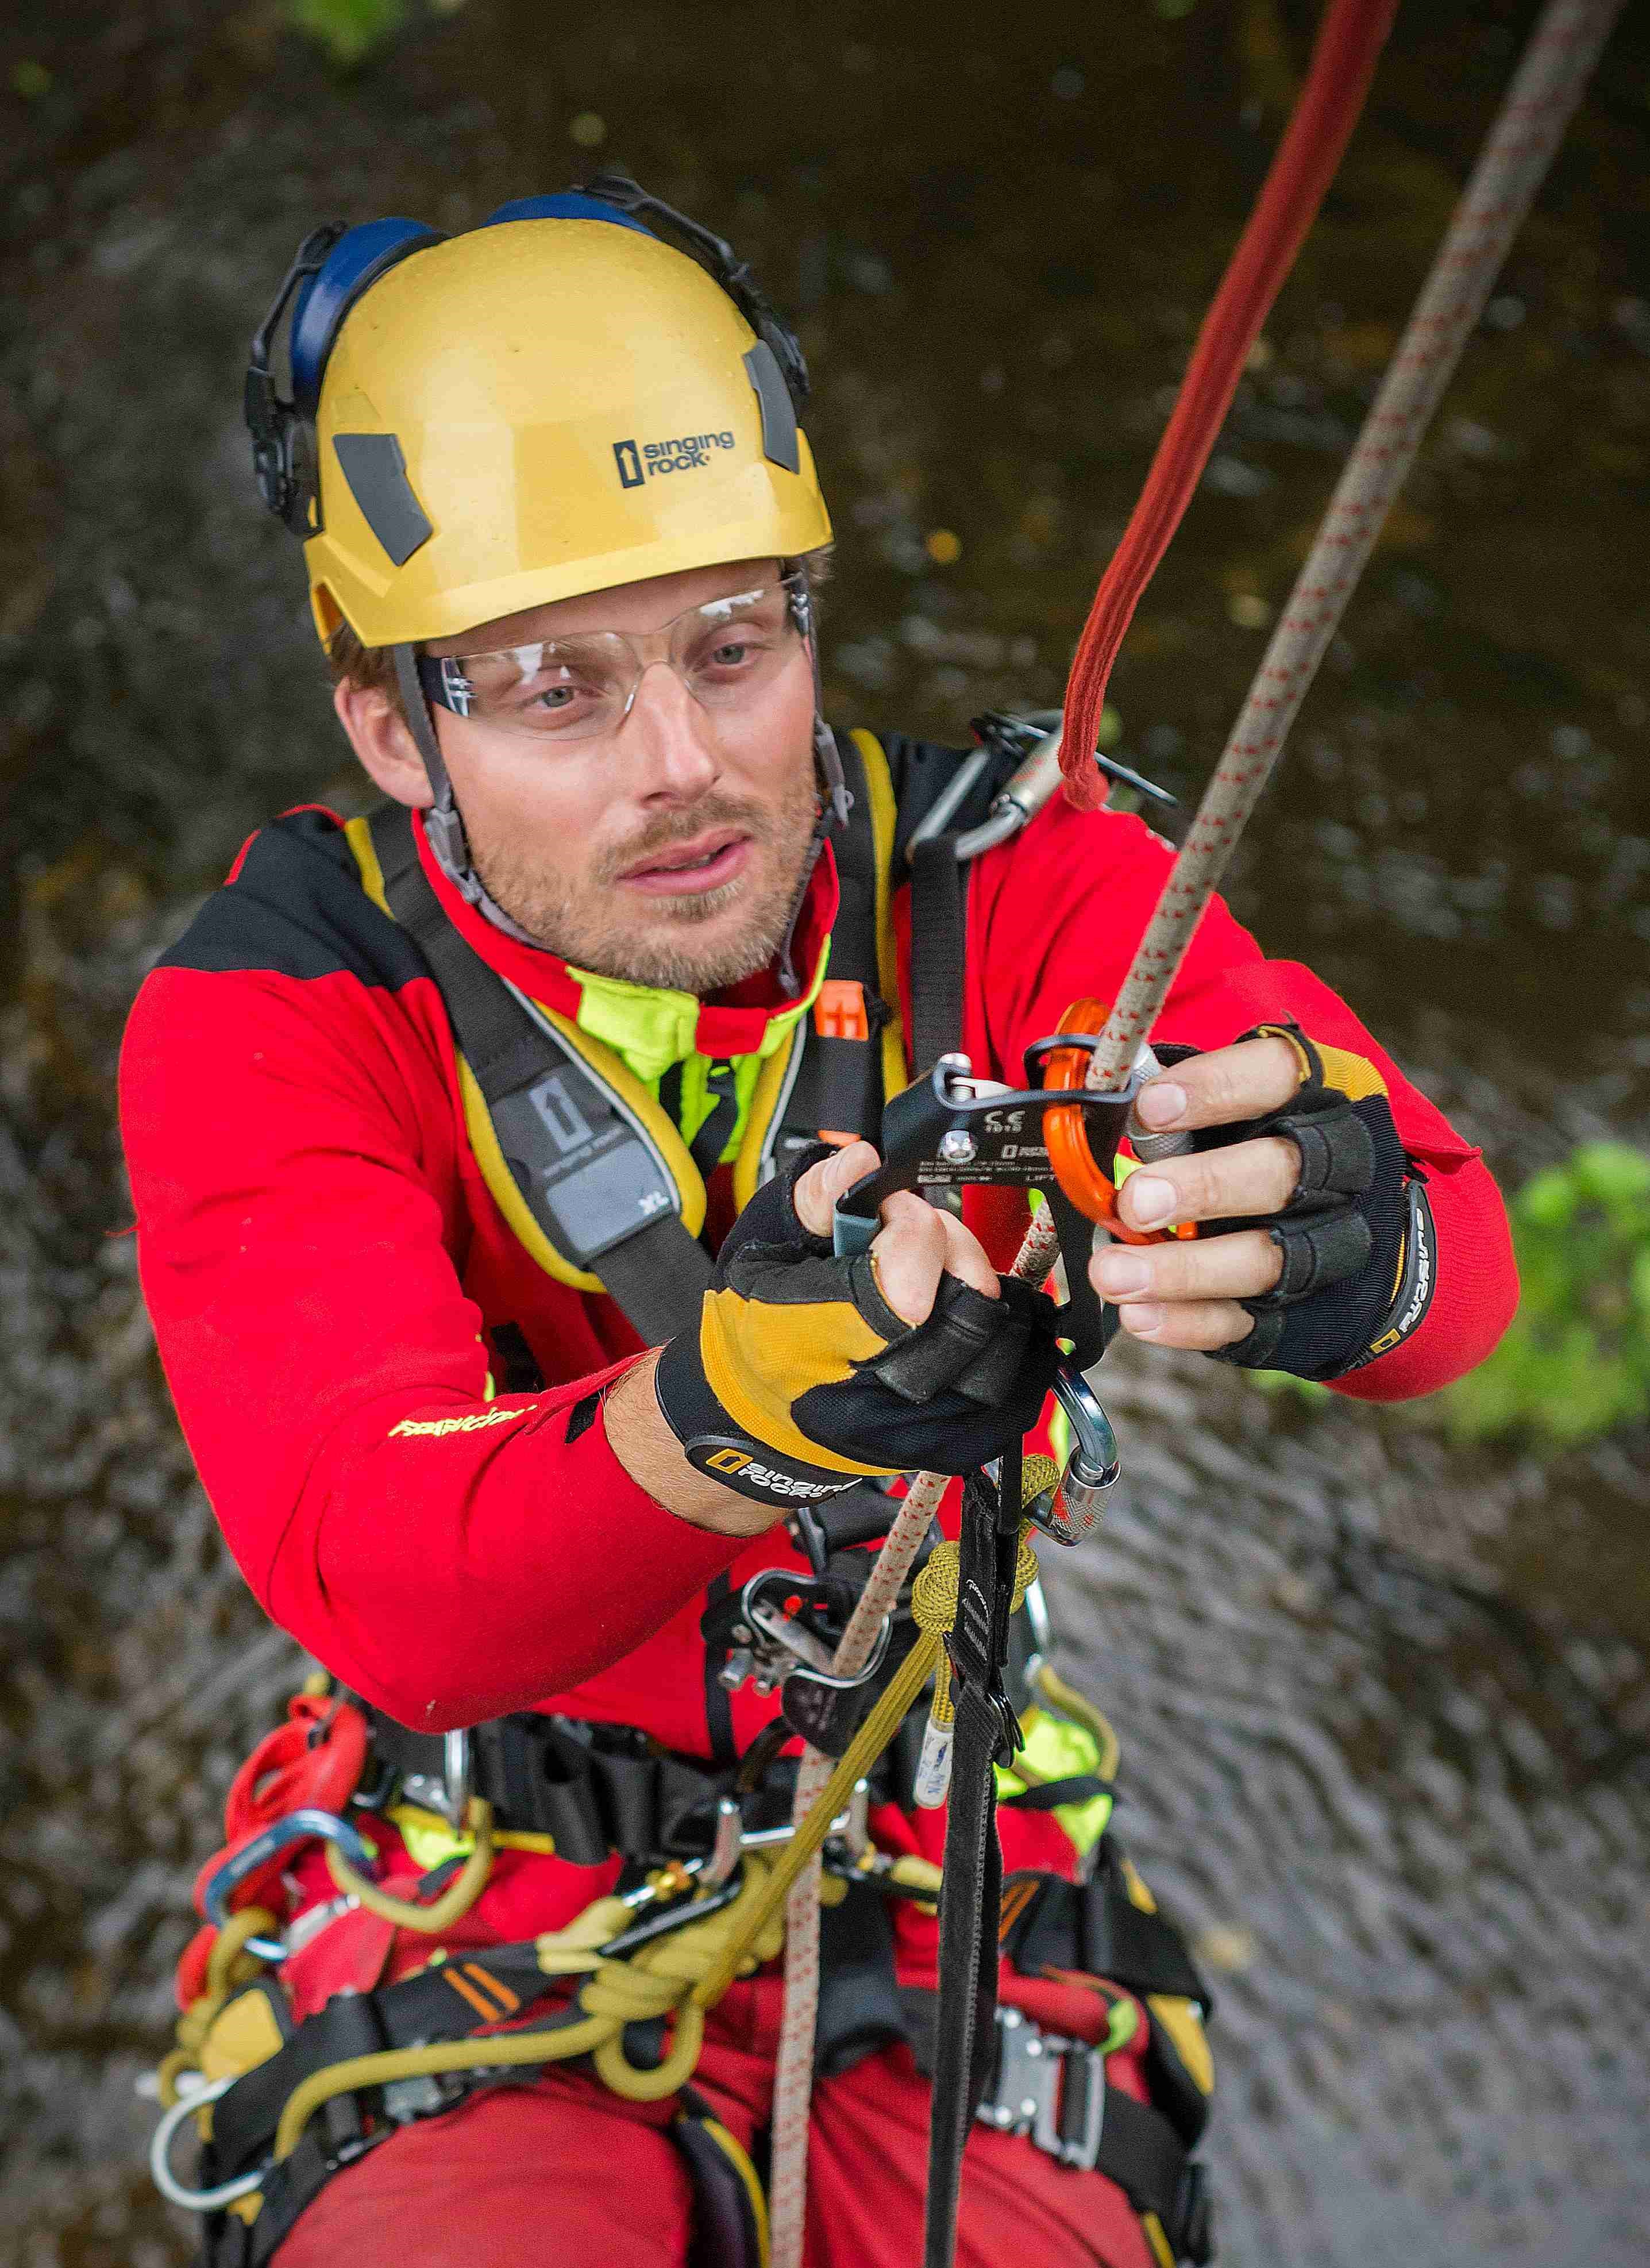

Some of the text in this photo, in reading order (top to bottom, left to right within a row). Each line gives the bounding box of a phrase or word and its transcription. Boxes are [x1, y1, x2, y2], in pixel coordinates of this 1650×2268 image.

[642, 430, 735, 459] singing
[647, 452, 707, 476] rock
[638, 1191, 669, 1215] XL
[738, 1468, 808, 1498] rock
